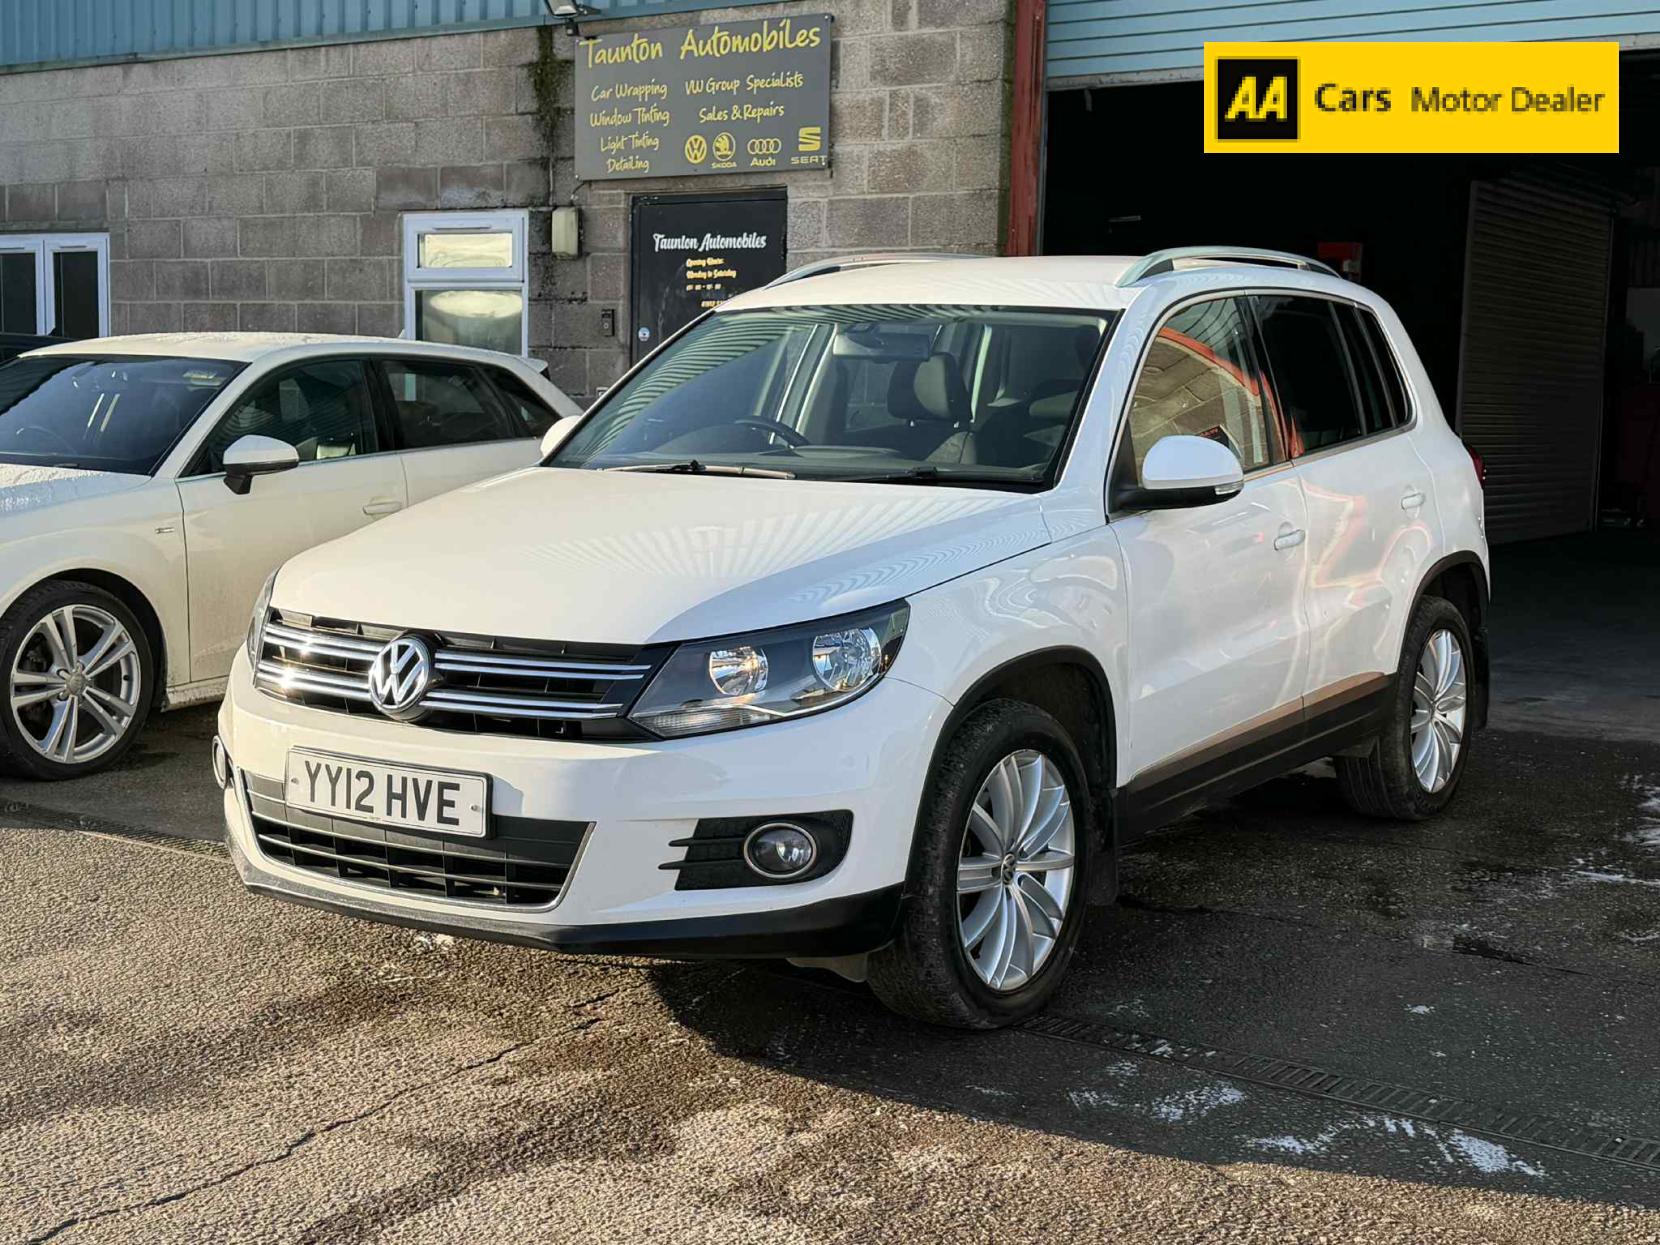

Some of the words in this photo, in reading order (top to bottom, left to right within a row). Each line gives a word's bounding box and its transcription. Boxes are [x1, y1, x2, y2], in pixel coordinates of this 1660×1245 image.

[579, 33, 663, 68] Taunton
[680, 18, 821, 60] Automobiles
[591, 85, 613, 101] Car
[615, 78, 668, 101] Wrapping
[705, 77, 740, 95] Group
[746, 71, 804, 95] Specialists
[589, 107, 632, 127] Window
[632, 102, 670, 127] Tinting
[699, 106, 729, 123] Sales
[731, 104, 742, 121] &
[743, 101, 785, 124] Repairs
[600, 135, 628, 155] Light
[628, 131, 660, 151] Tinting
[606, 155, 650, 173] Detailing
[750, 157, 776, 167] Audi
[790, 155, 828, 165] SEAT
[653, 233, 699, 252] Taunton
[698, 232, 767, 252] Automobiles
[304, 760, 375, 814] YY12
[386, 774, 461, 826] HVE
